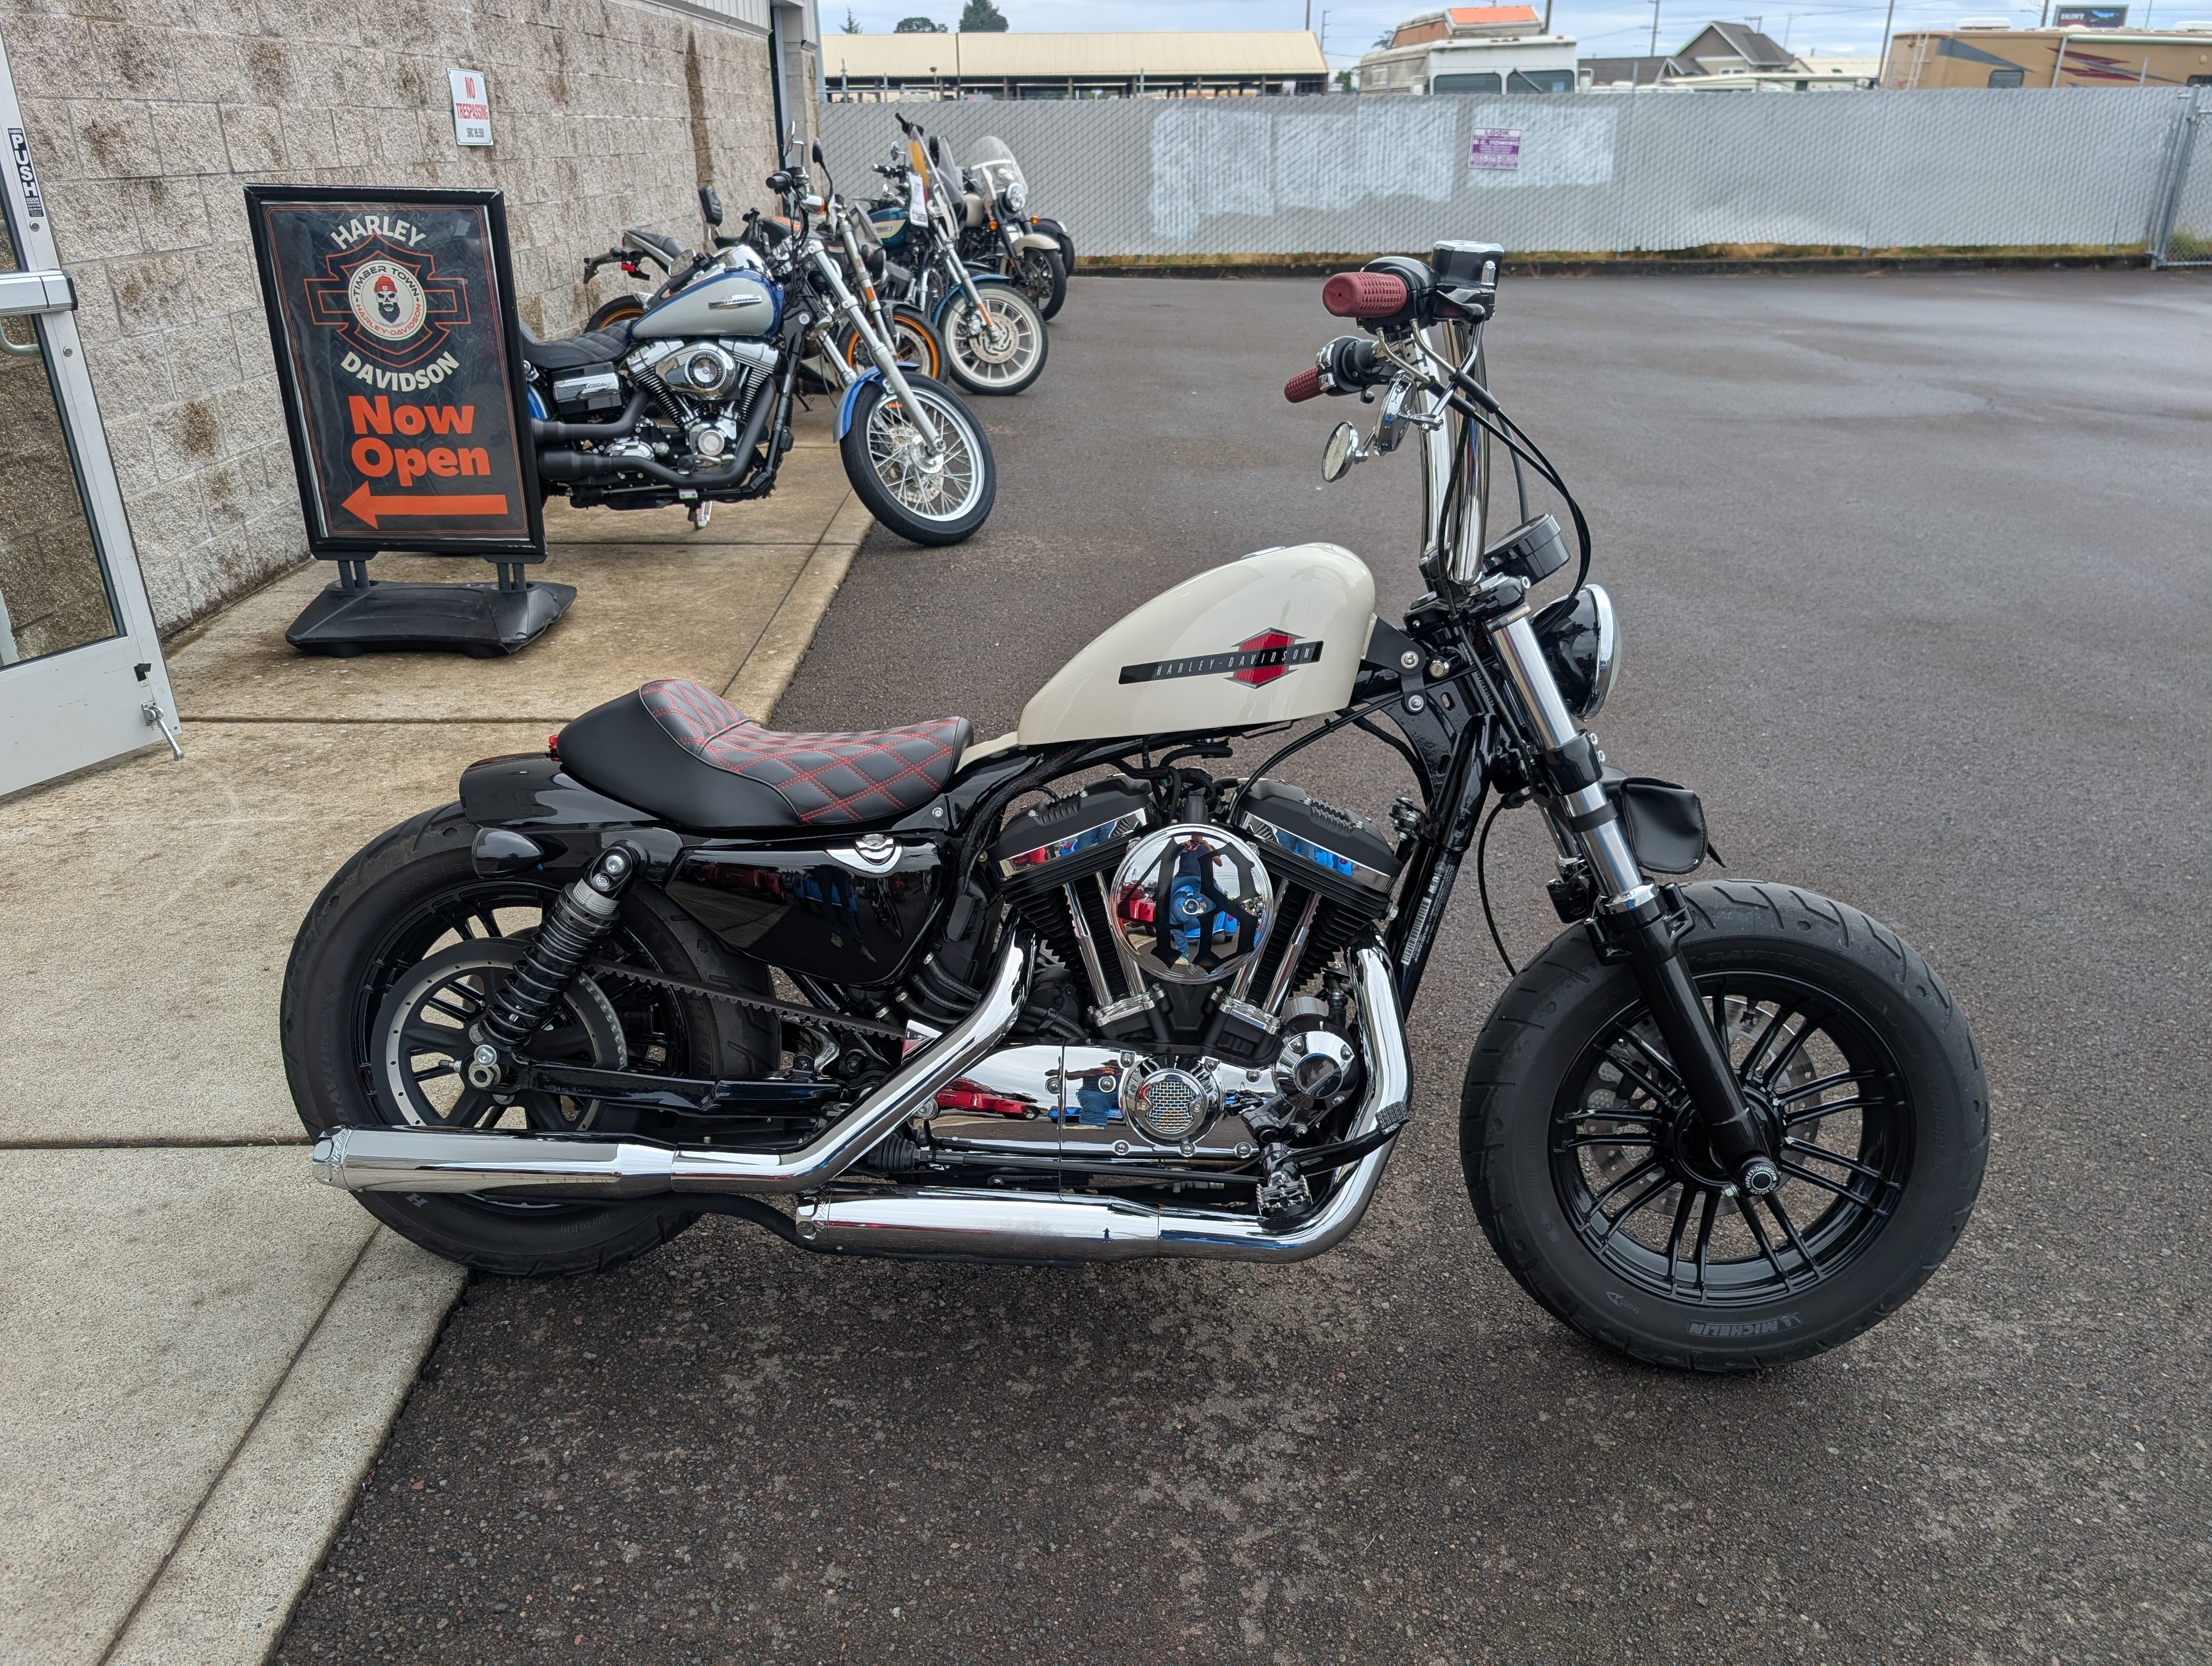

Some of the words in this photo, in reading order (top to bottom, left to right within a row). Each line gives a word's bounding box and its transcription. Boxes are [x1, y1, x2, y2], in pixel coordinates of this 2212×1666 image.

[465, 76, 475, 99] NO
[455, 102, 488, 120] TRESPASSING
[11, 134, 38, 196] PUSH
[330, 215, 426, 249] HARLEY
[353, 265, 387, 296] TIMBER
[391, 267, 420, 297] TOWN
[356, 304, 421, 335] HARLEY-DAVIDSON
[340, 352, 460, 392] DAVIDSON
[348, 395, 475, 434] Now
[351, 437, 491, 486] Open
[1156, 647, 1311, 677] HARLEY-DAVIDSON
[401, 863, 462, 895] SCORCHER
[1688, 1320, 1778, 1336] MICHELIN
